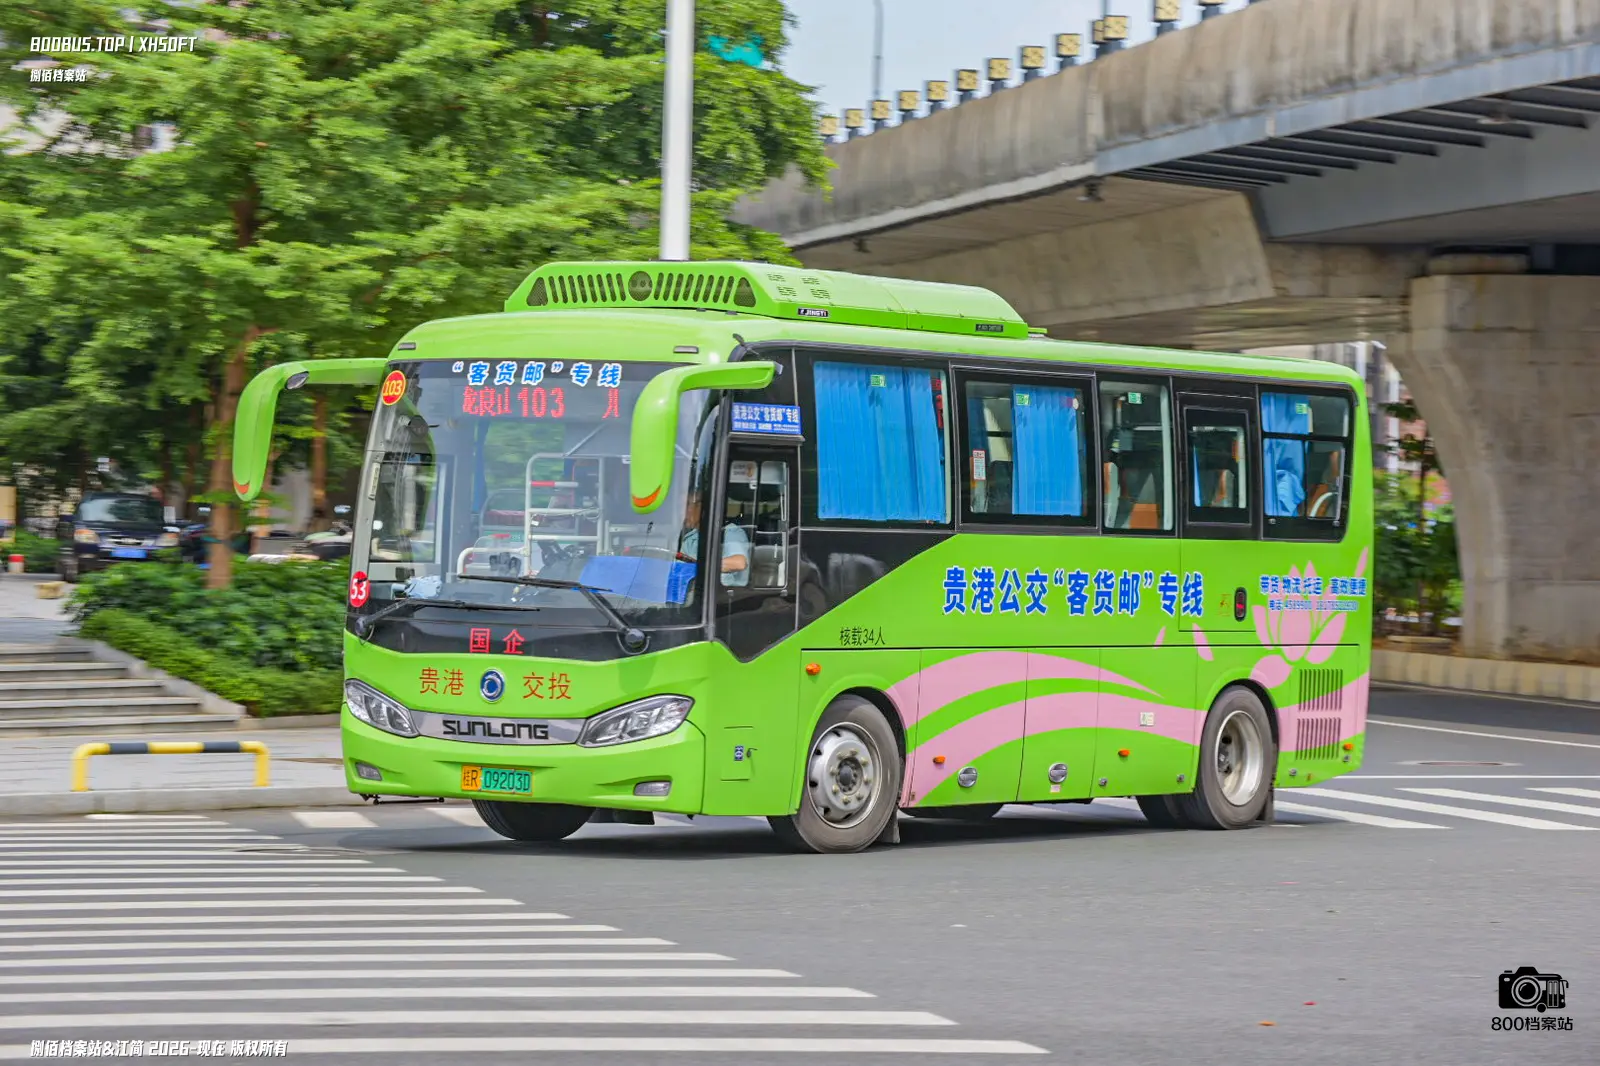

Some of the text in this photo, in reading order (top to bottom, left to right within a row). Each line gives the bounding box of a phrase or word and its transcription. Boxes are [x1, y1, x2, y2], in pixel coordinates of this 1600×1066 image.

[382, 379, 403, 397] 103
[518, 386, 565, 418] 103
[350, 578, 367, 600] 53
[469, 627, 526, 654] 国企
[840, 626, 886, 646] 核载34人
[418, 667, 572, 700] 贵港 交投
[442, 719, 549, 740] SUNLONG
